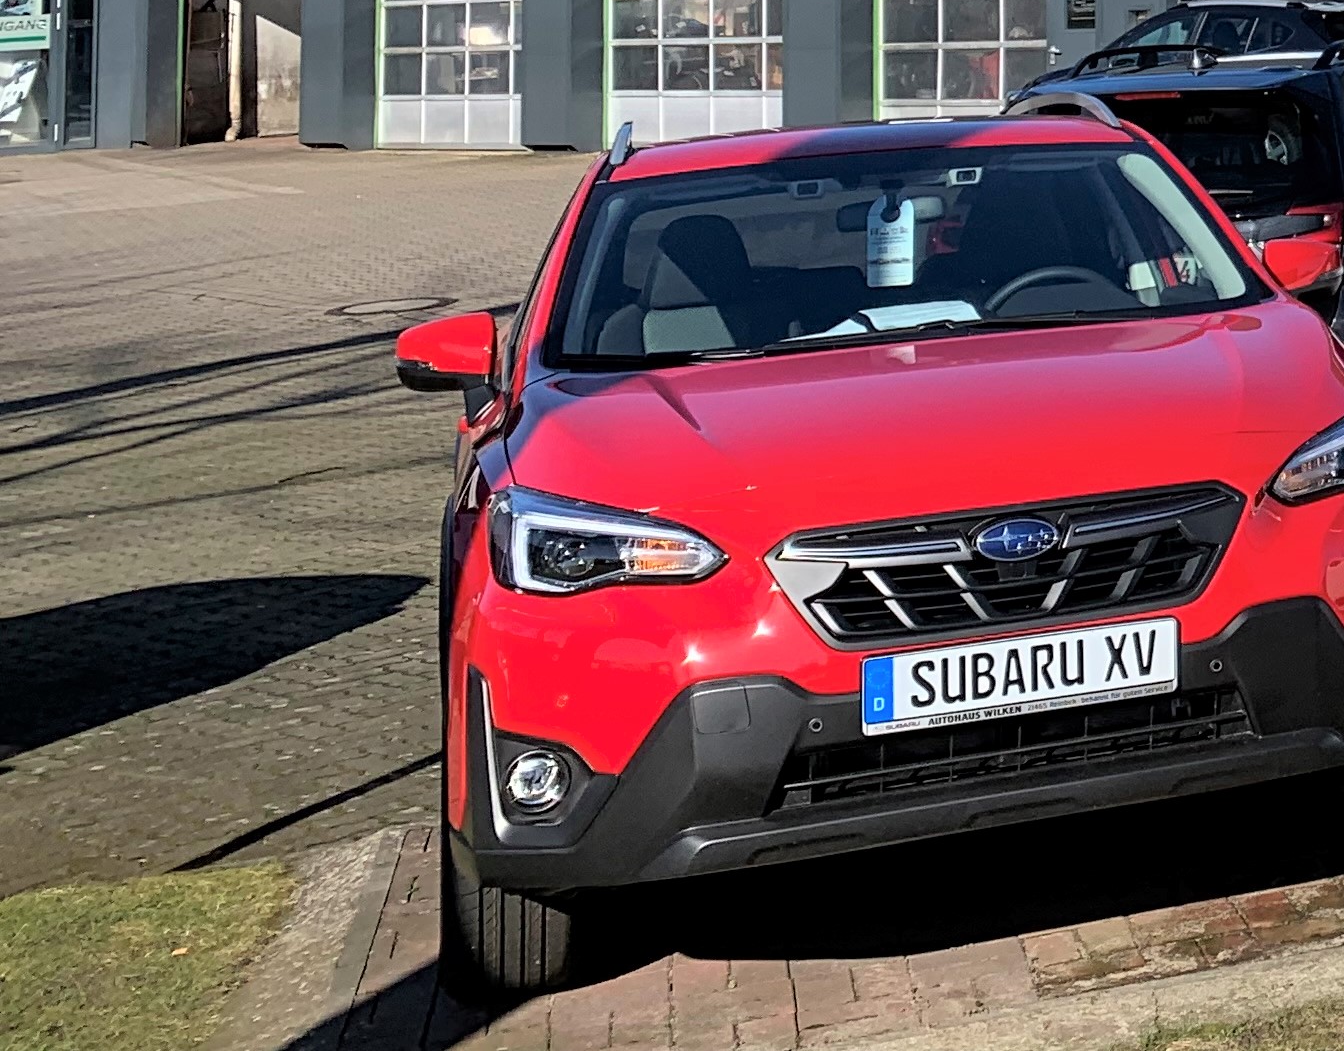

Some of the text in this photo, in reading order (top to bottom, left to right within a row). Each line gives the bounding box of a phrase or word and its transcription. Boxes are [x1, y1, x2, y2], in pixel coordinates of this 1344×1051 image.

[911, 630, 1156, 708] SUBARU XV
[873, 697, 885, 712] D
[885, 721, 920, 731] SUBARU
[927, 711, 981, 726] AUTOHAUS
[984, 705, 1023, 718] WILKEN
[1144, 684, 1169, 694] Service
